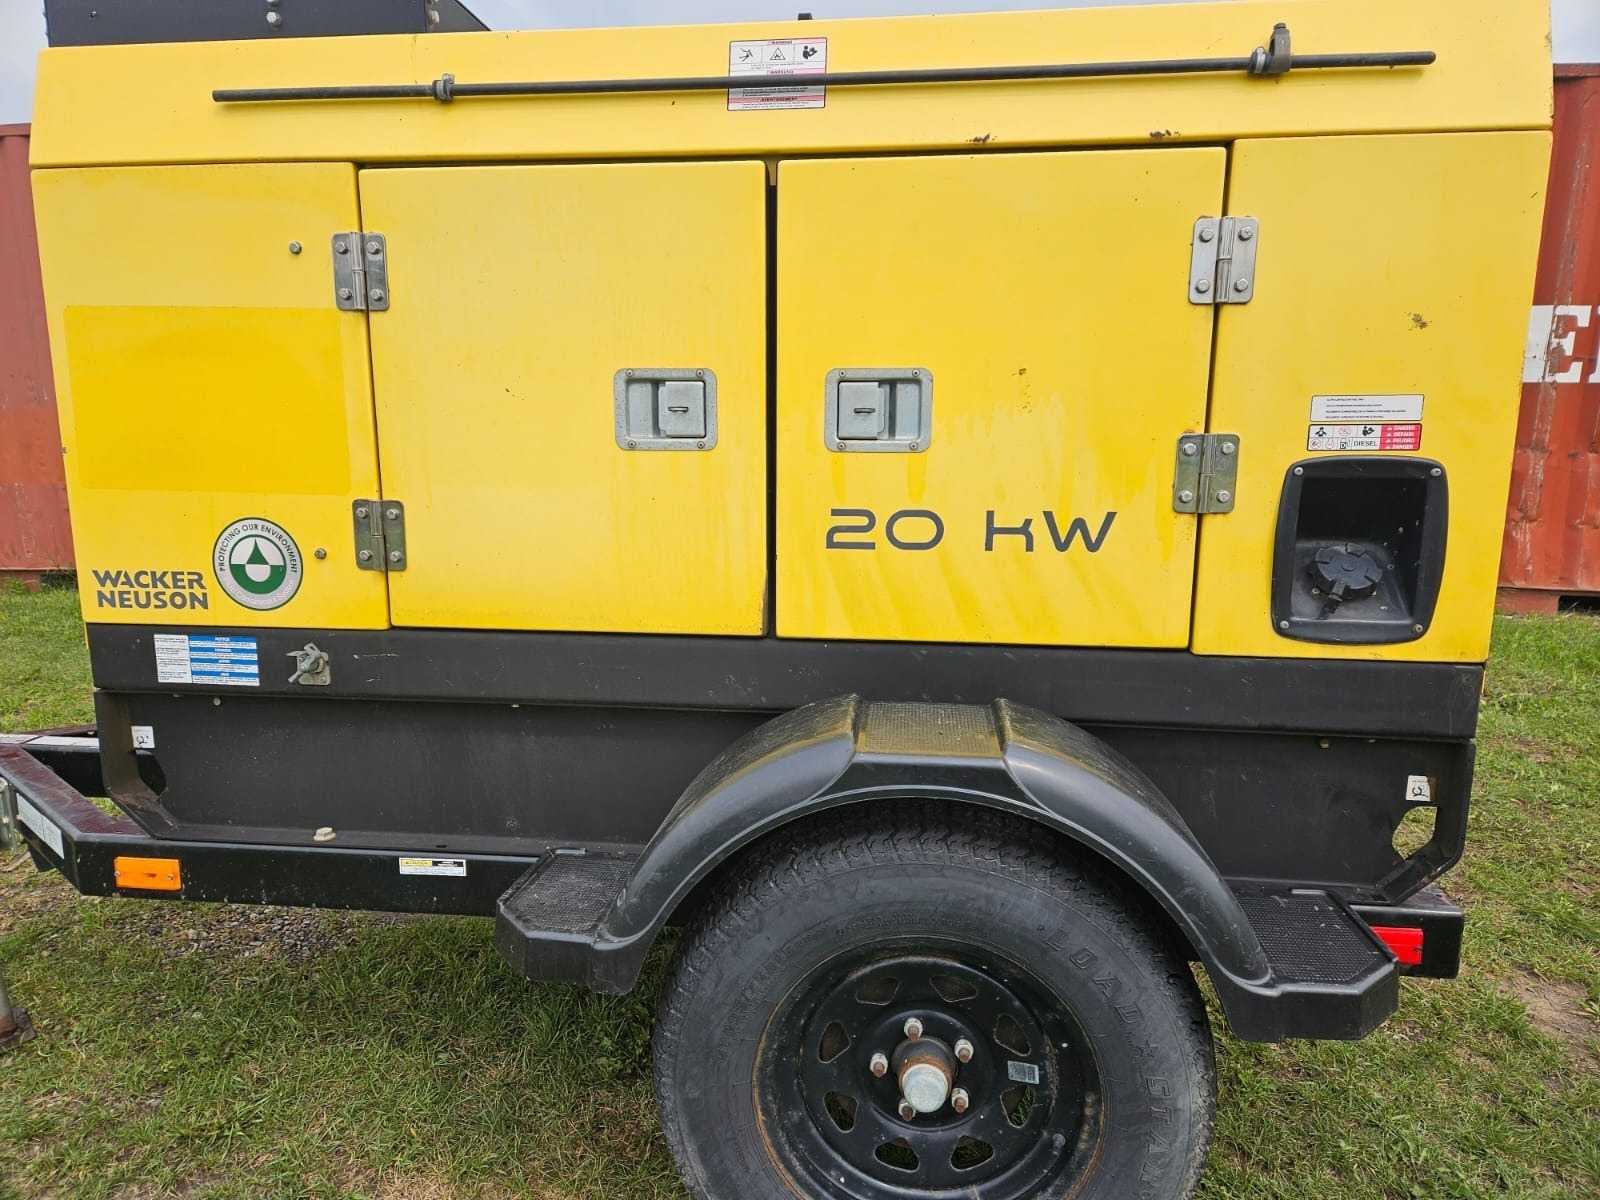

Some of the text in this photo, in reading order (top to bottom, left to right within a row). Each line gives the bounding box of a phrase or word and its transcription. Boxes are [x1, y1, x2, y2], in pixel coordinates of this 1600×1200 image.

[1353, 439, 1377, 447] DIESEL
[826, 508, 945, 551] 20
[219, 523, 298, 574] PROTECTING OUR ENVIRONMENT
[92, 570, 206, 590] WACKER
[97, 590, 209, 610] NEUSON
[1044, 928, 1144, 1024] LOAD
